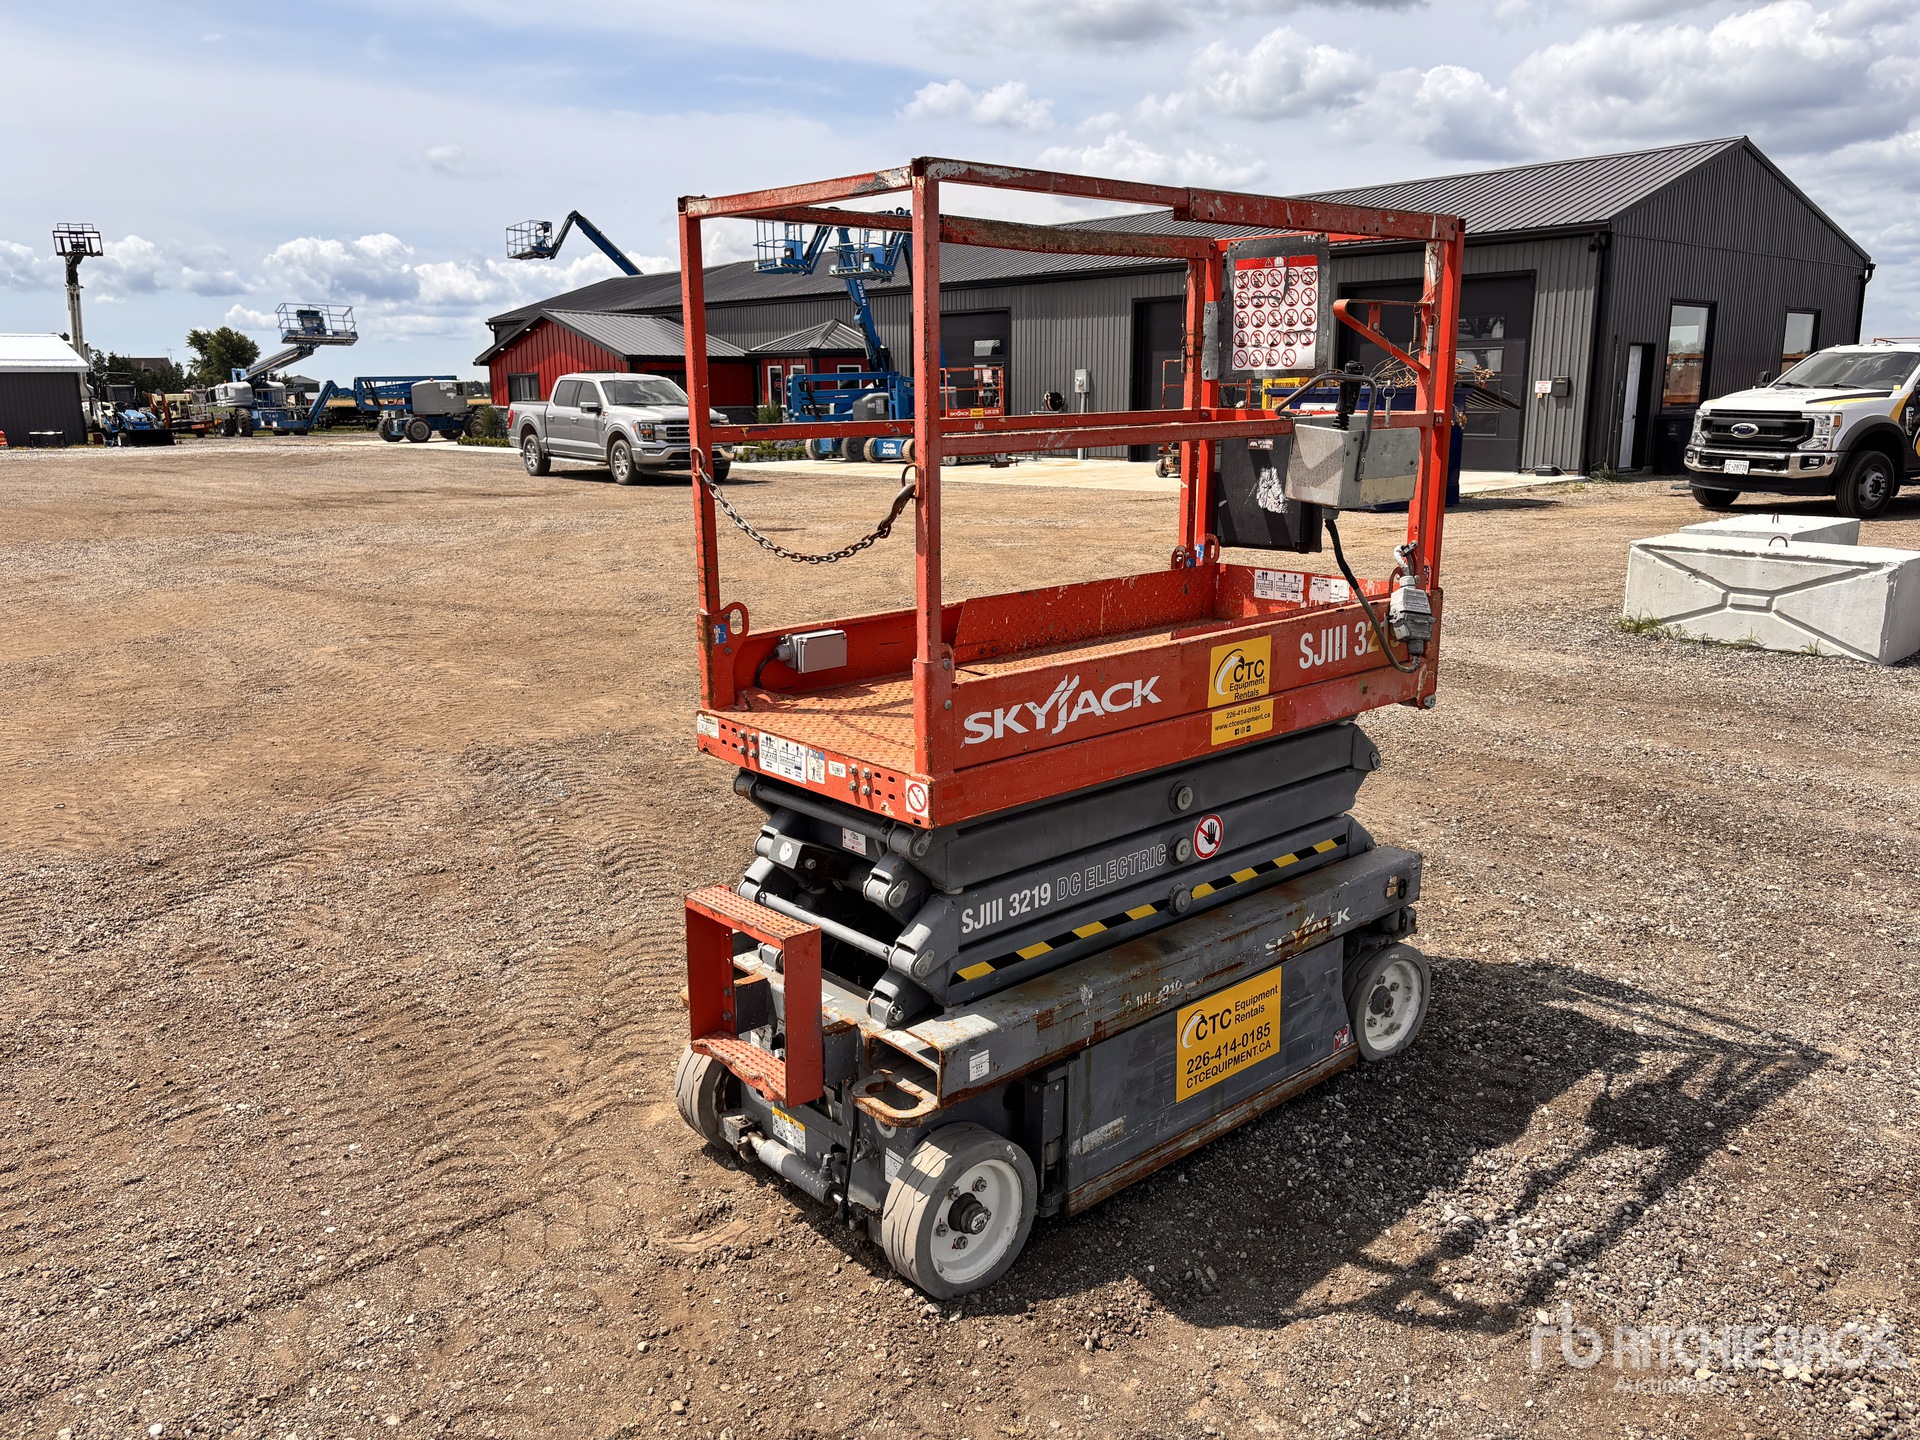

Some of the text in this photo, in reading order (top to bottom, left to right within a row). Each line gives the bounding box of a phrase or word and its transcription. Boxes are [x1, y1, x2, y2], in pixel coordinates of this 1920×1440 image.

[1354, 612, 1401, 656] 321
[1229, 676, 1265, 691] Equipment
[1233, 657, 1265, 683] CTC
[961, 675, 1162, 746] SKYJACK
[1234, 688, 1259, 700] Rentals
[1214, 712, 1270, 731] www.ctcequipment.ca
[1226, 705, 1260, 719] 226-414-0185
[1009, 882, 1051, 918] 3219
[1056, 872, 1081, 902] DC
[1084, 843, 1167, 892] ELECTRIC
[1195, 984, 1279, 1041] CTC Equipment
[1234, 1003, 1265, 1025] Rentals
[1186, 1021, 1271, 1075] 226-414-0185
[1186, 1039, 1272, 1089] CTCEQUIPMENT.CA
